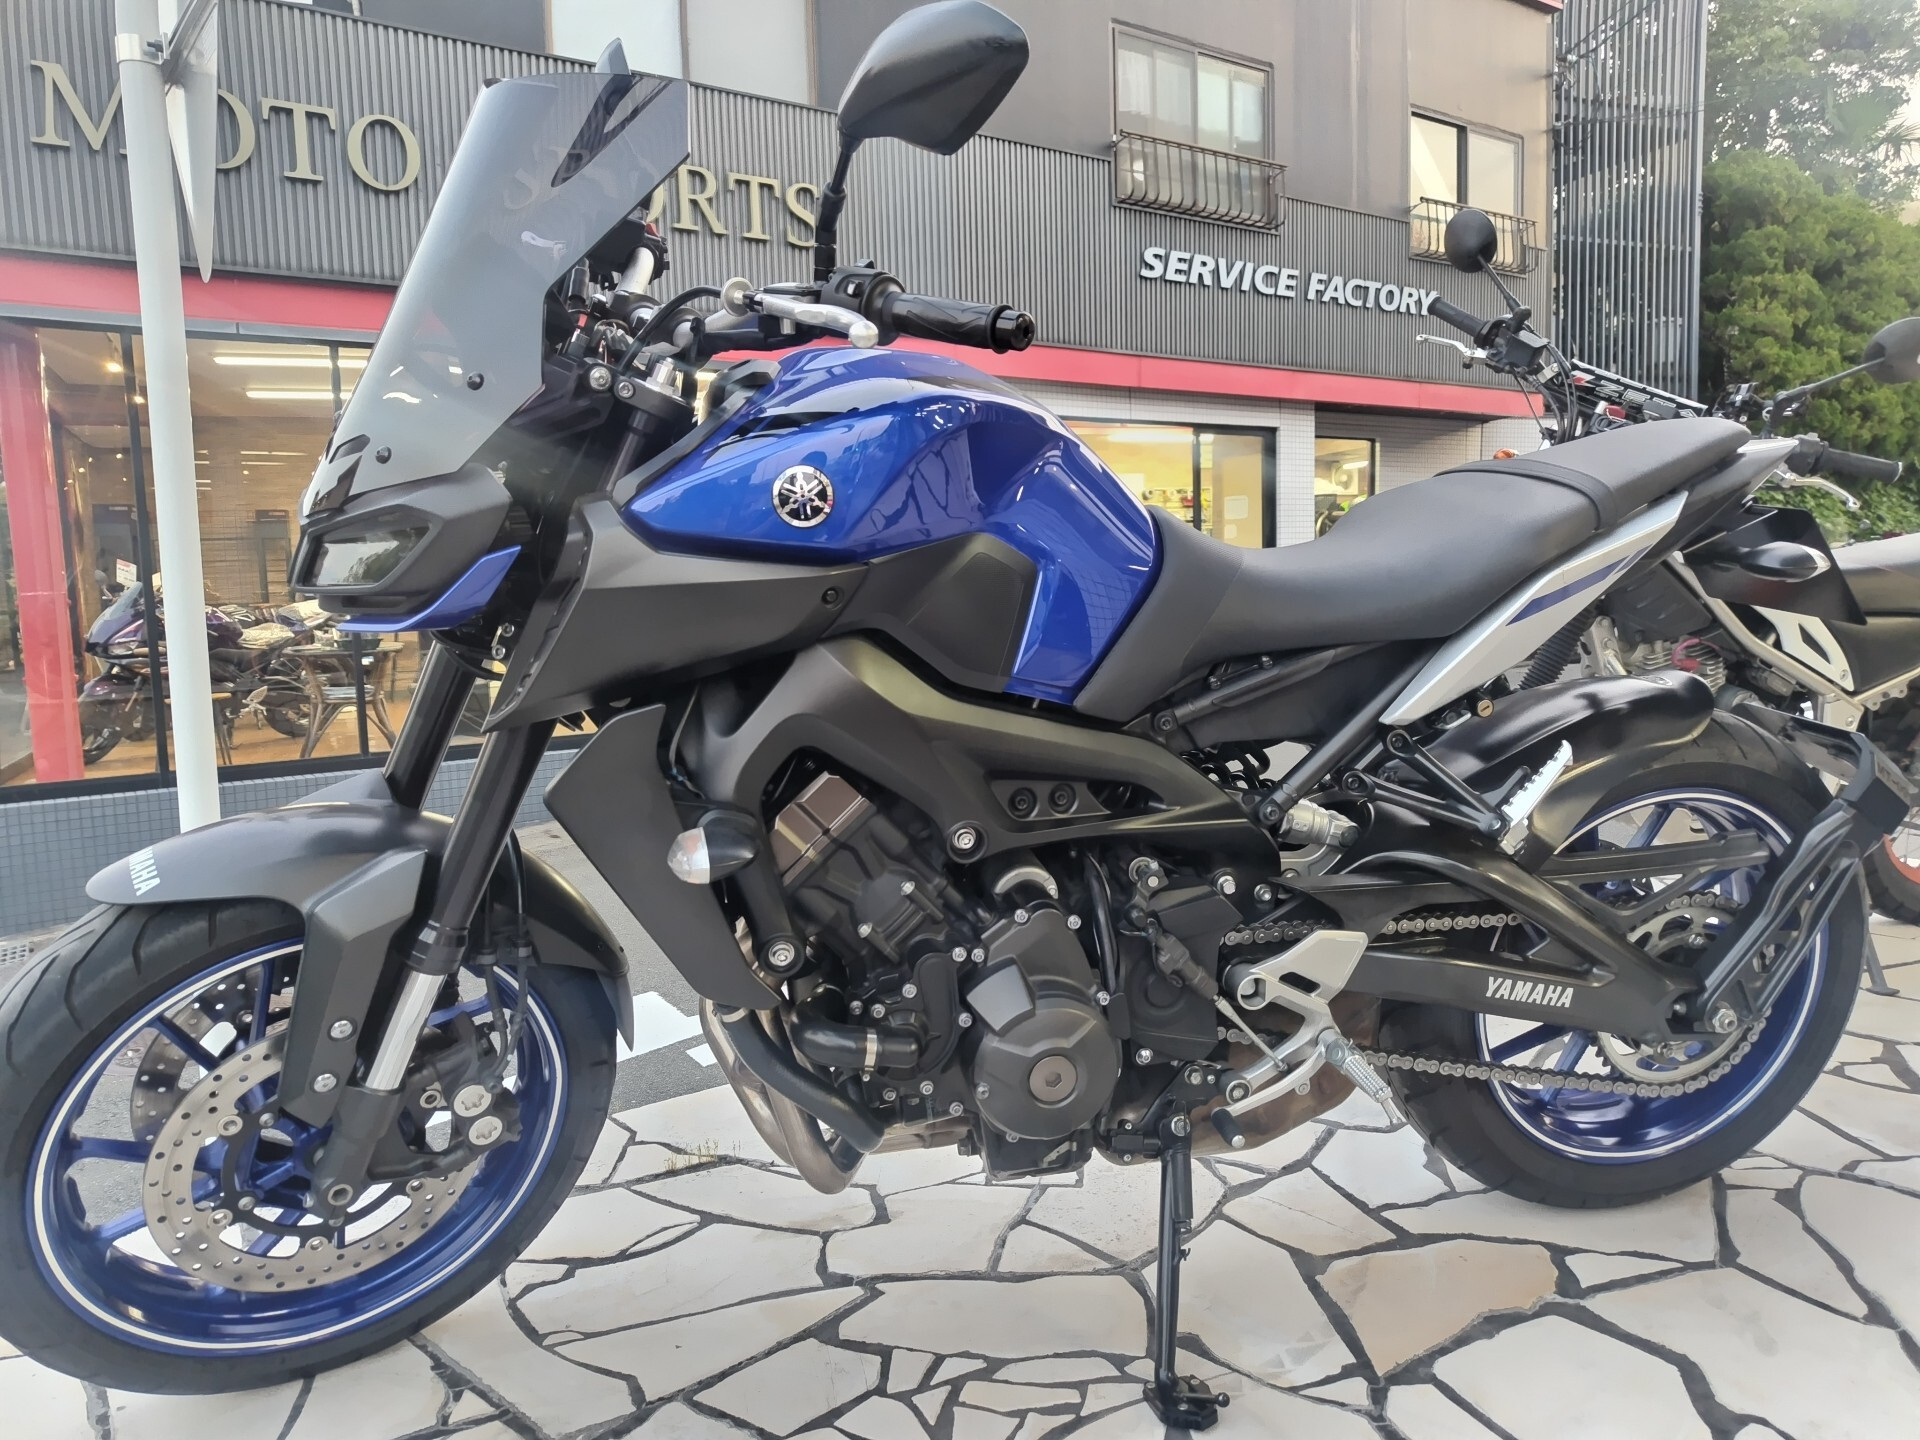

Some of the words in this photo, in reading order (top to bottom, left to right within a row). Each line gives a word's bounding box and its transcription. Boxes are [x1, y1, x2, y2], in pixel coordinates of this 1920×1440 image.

[1140, 246, 1299, 298] SERVICE
[1306, 271, 1439, 316] FACTORY
[128, 846, 161, 896] MAHA
[1485, 976, 1575, 1008] YAMAHA
